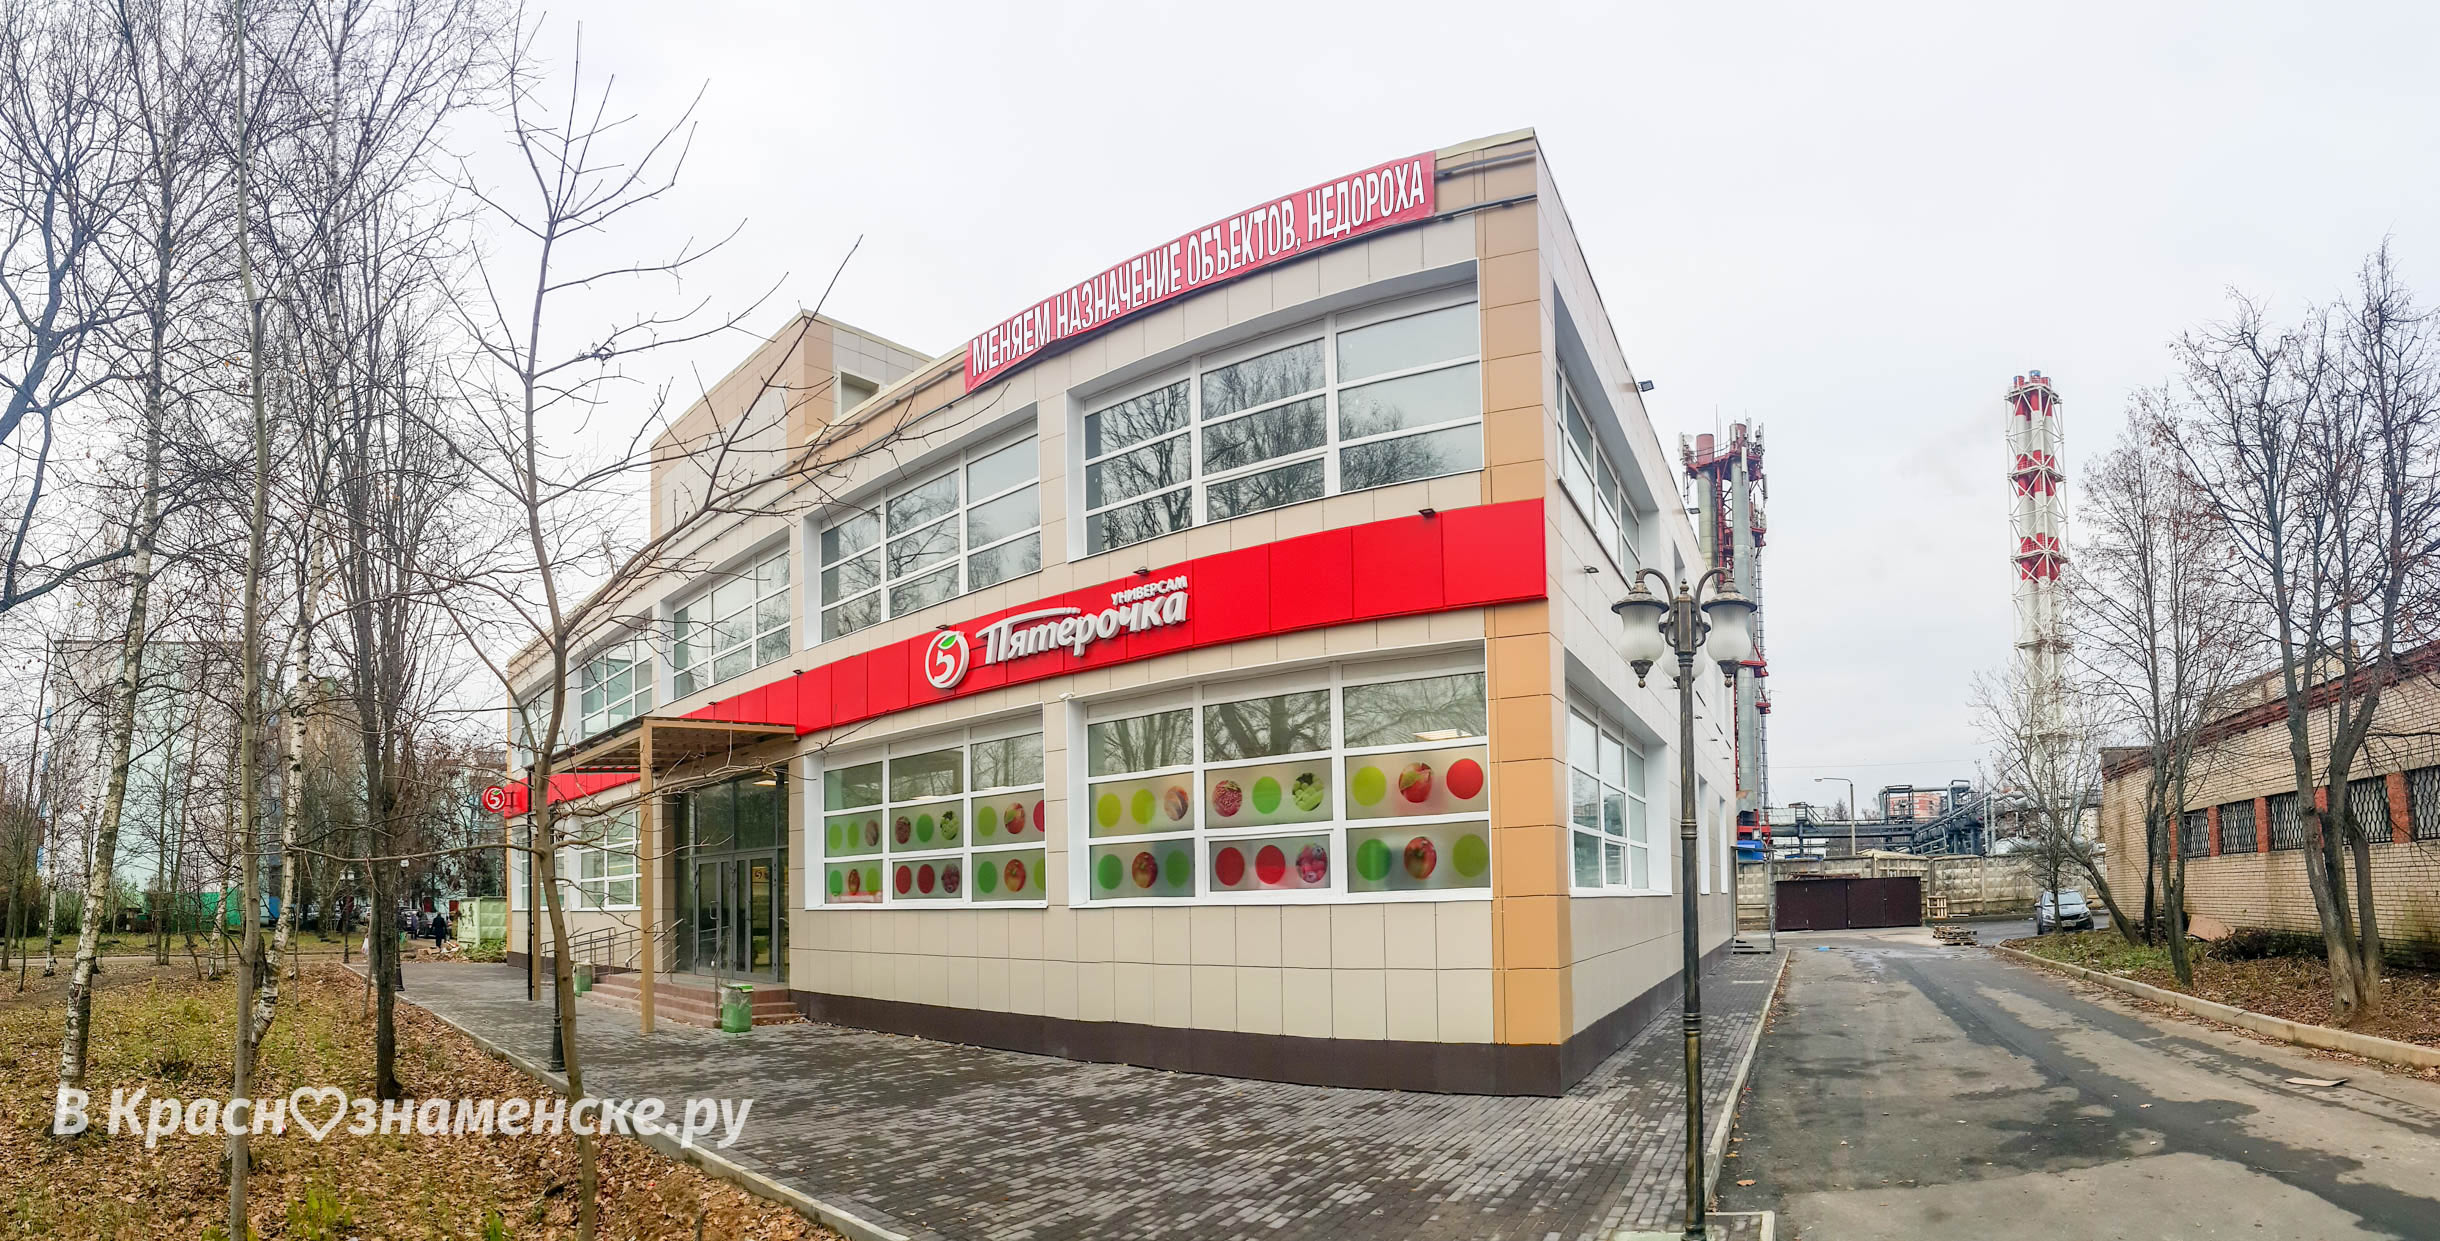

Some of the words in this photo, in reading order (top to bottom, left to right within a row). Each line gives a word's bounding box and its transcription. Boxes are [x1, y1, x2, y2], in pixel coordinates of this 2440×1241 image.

[971, 311, 1051, 376] МЕНЯЕМ
[1056, 241, 1182, 340] НАЗНАЧЕНИЕ
[1186, 199, 1303, 286] ОБЪЕКТОВ,
[1307, 160, 1425, 243] НЕДОРОХА
[1111, 575, 1188, 605] УНИВЕРСАМ
